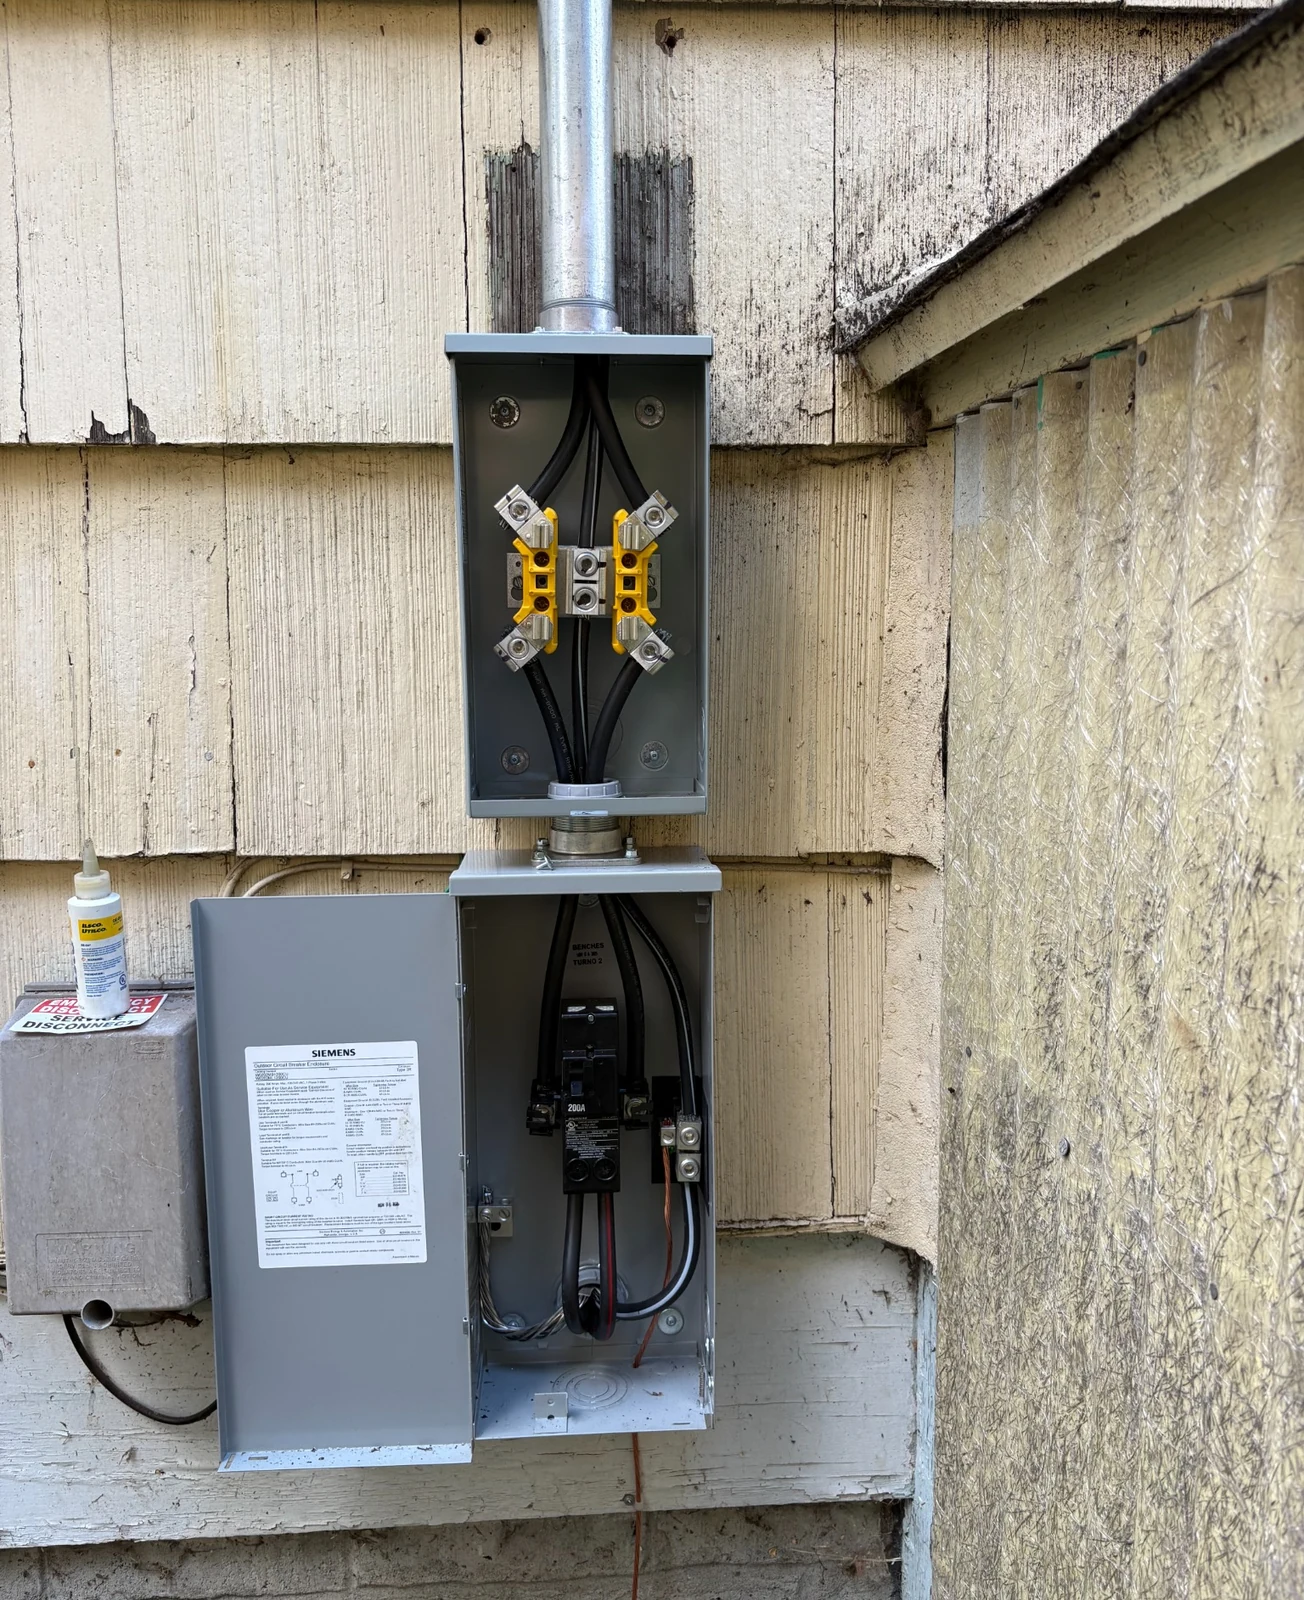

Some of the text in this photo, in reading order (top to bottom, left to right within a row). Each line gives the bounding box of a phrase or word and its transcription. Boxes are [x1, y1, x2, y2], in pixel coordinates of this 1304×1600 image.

[572, 942, 605, 951] BENCHES
[573, 958, 597, 966] TURNO
[38, 1005, 152, 1014] DISCCT
[50, 1014, 126, 1023] SERE
[22, 1020, 138, 1030] DISCONNECT
[311, 1048, 356, 1058] SIEMENS
[567, 1103, 586, 1112] 200A
